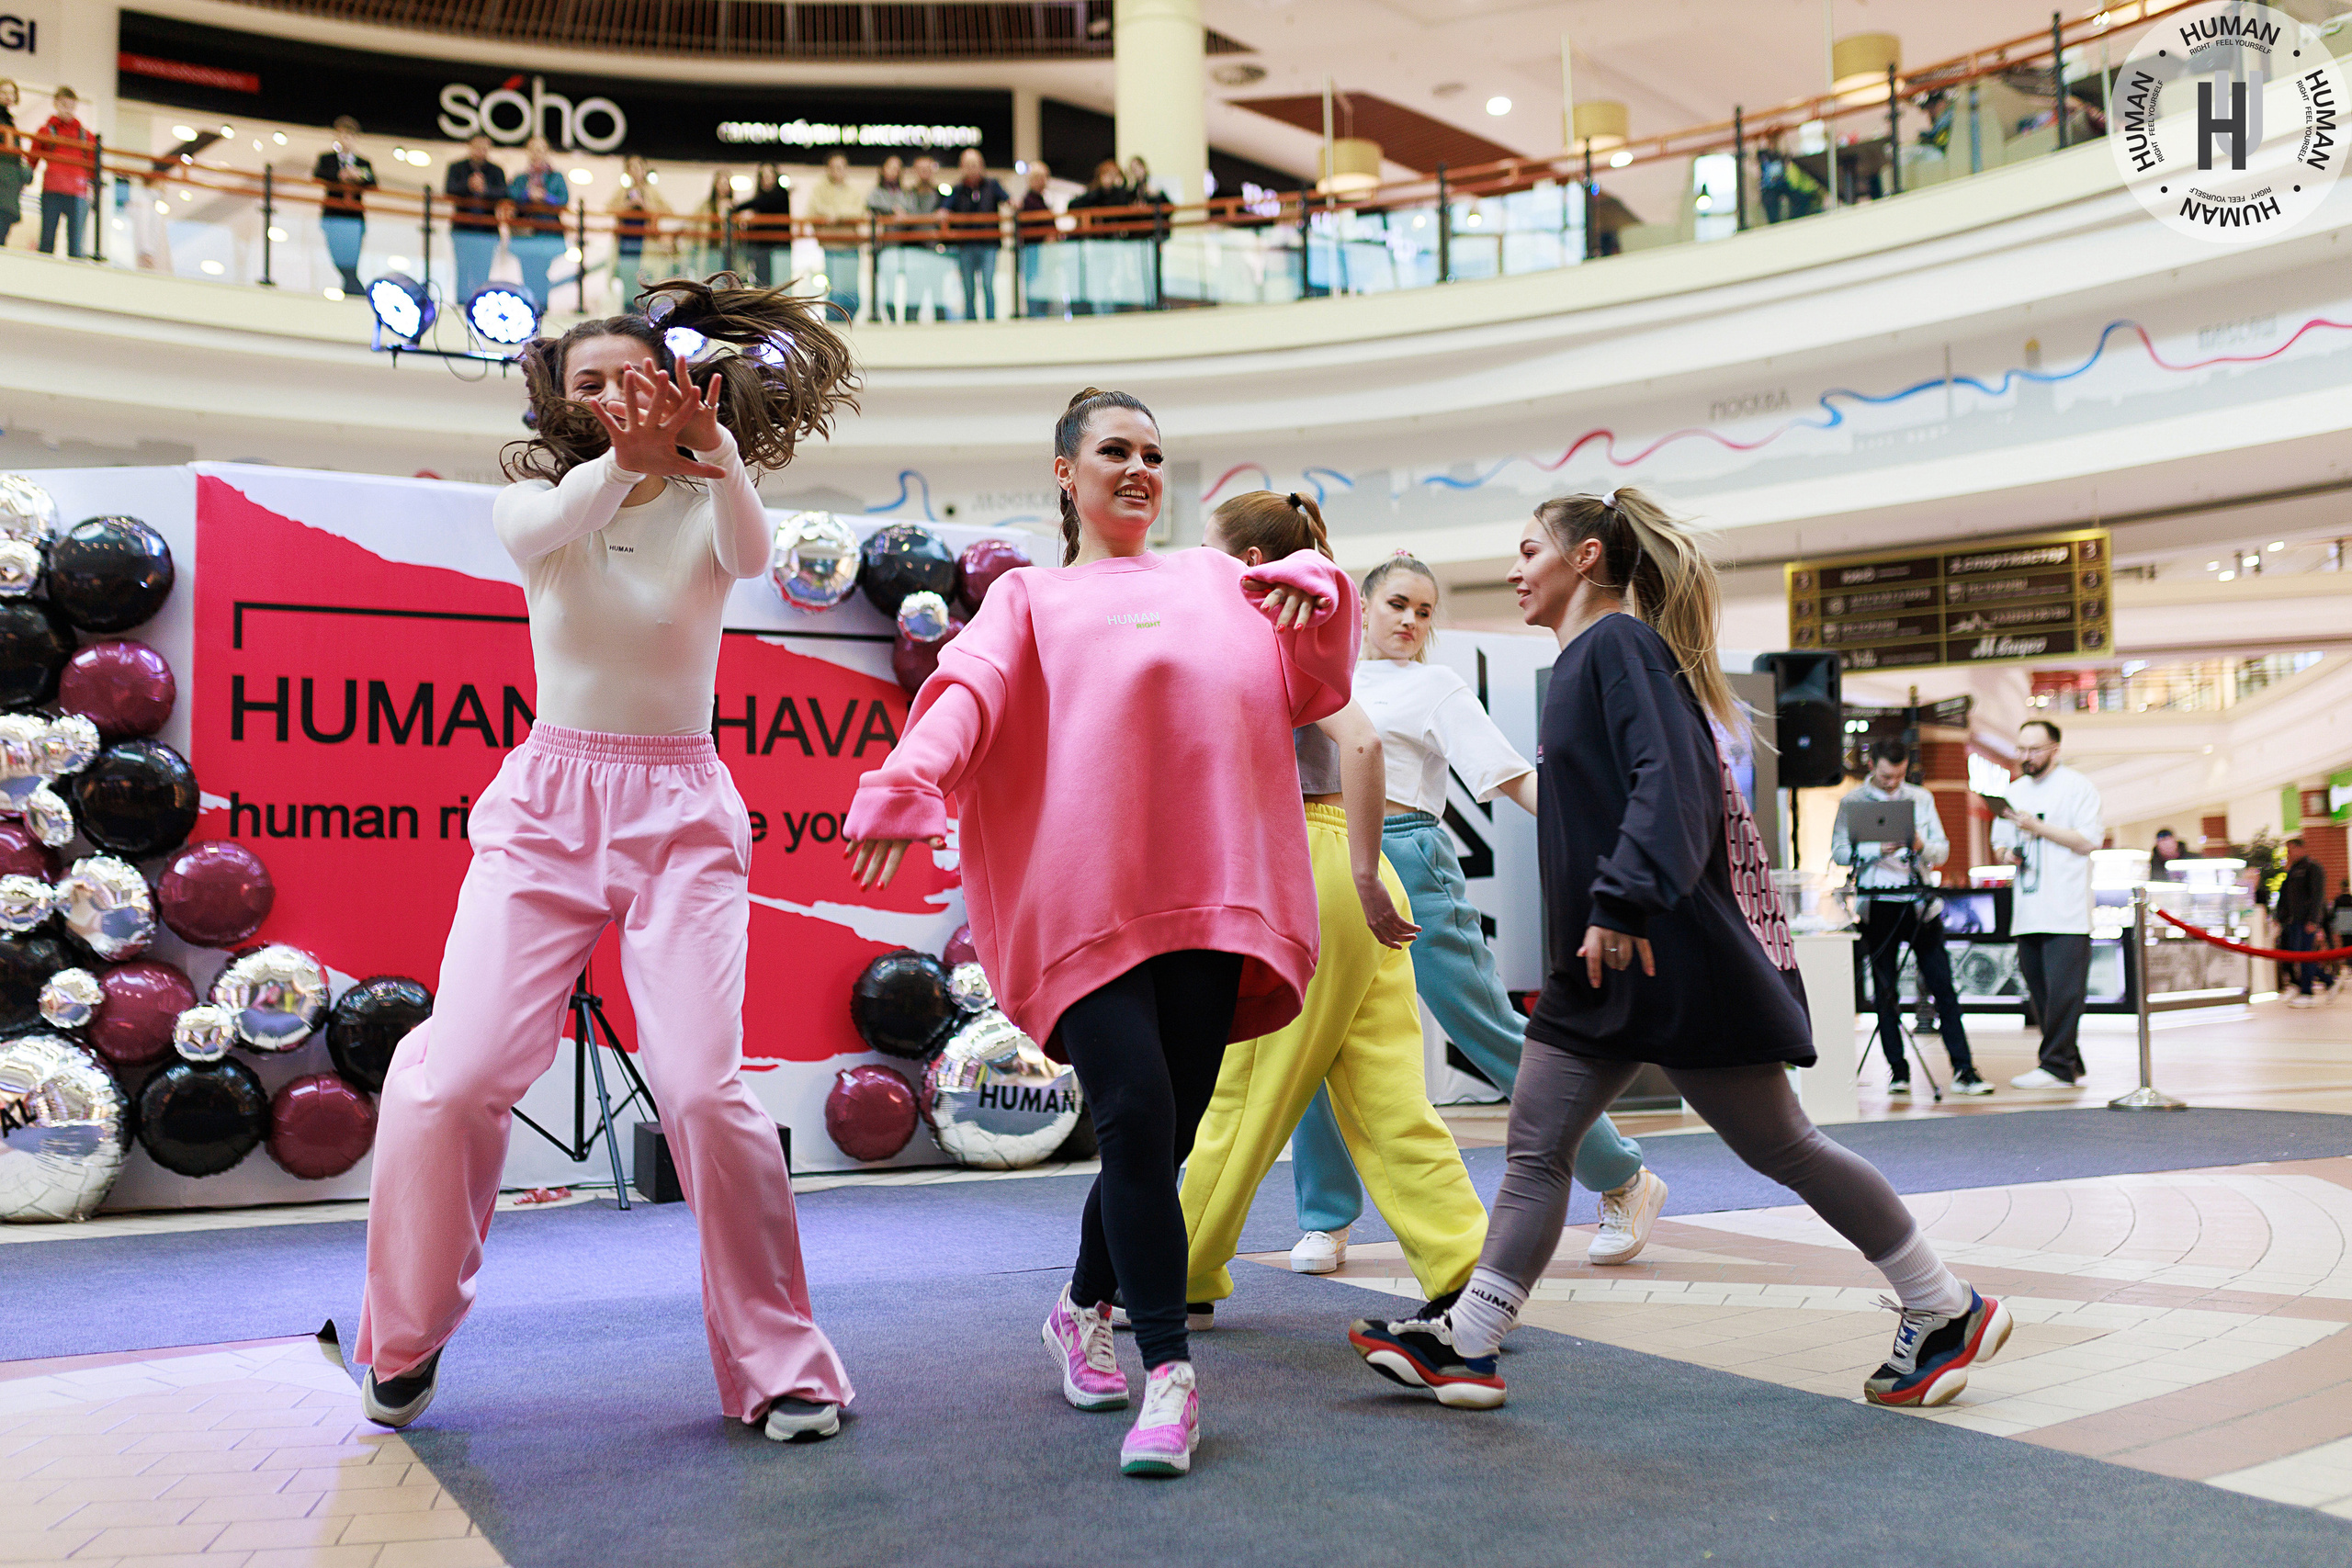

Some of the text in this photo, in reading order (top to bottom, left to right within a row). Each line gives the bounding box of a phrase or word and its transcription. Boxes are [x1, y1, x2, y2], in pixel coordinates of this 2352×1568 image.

[609, 545, 634, 553] HUMAN
[1107, 612, 1160, 625] HUMAN
[1136, 621, 1160, 629] RIGHT
[712, 694, 914, 757] HAVA
[230, 792, 418, 839] human
[978, 1083, 1076, 1113] HUMAN
